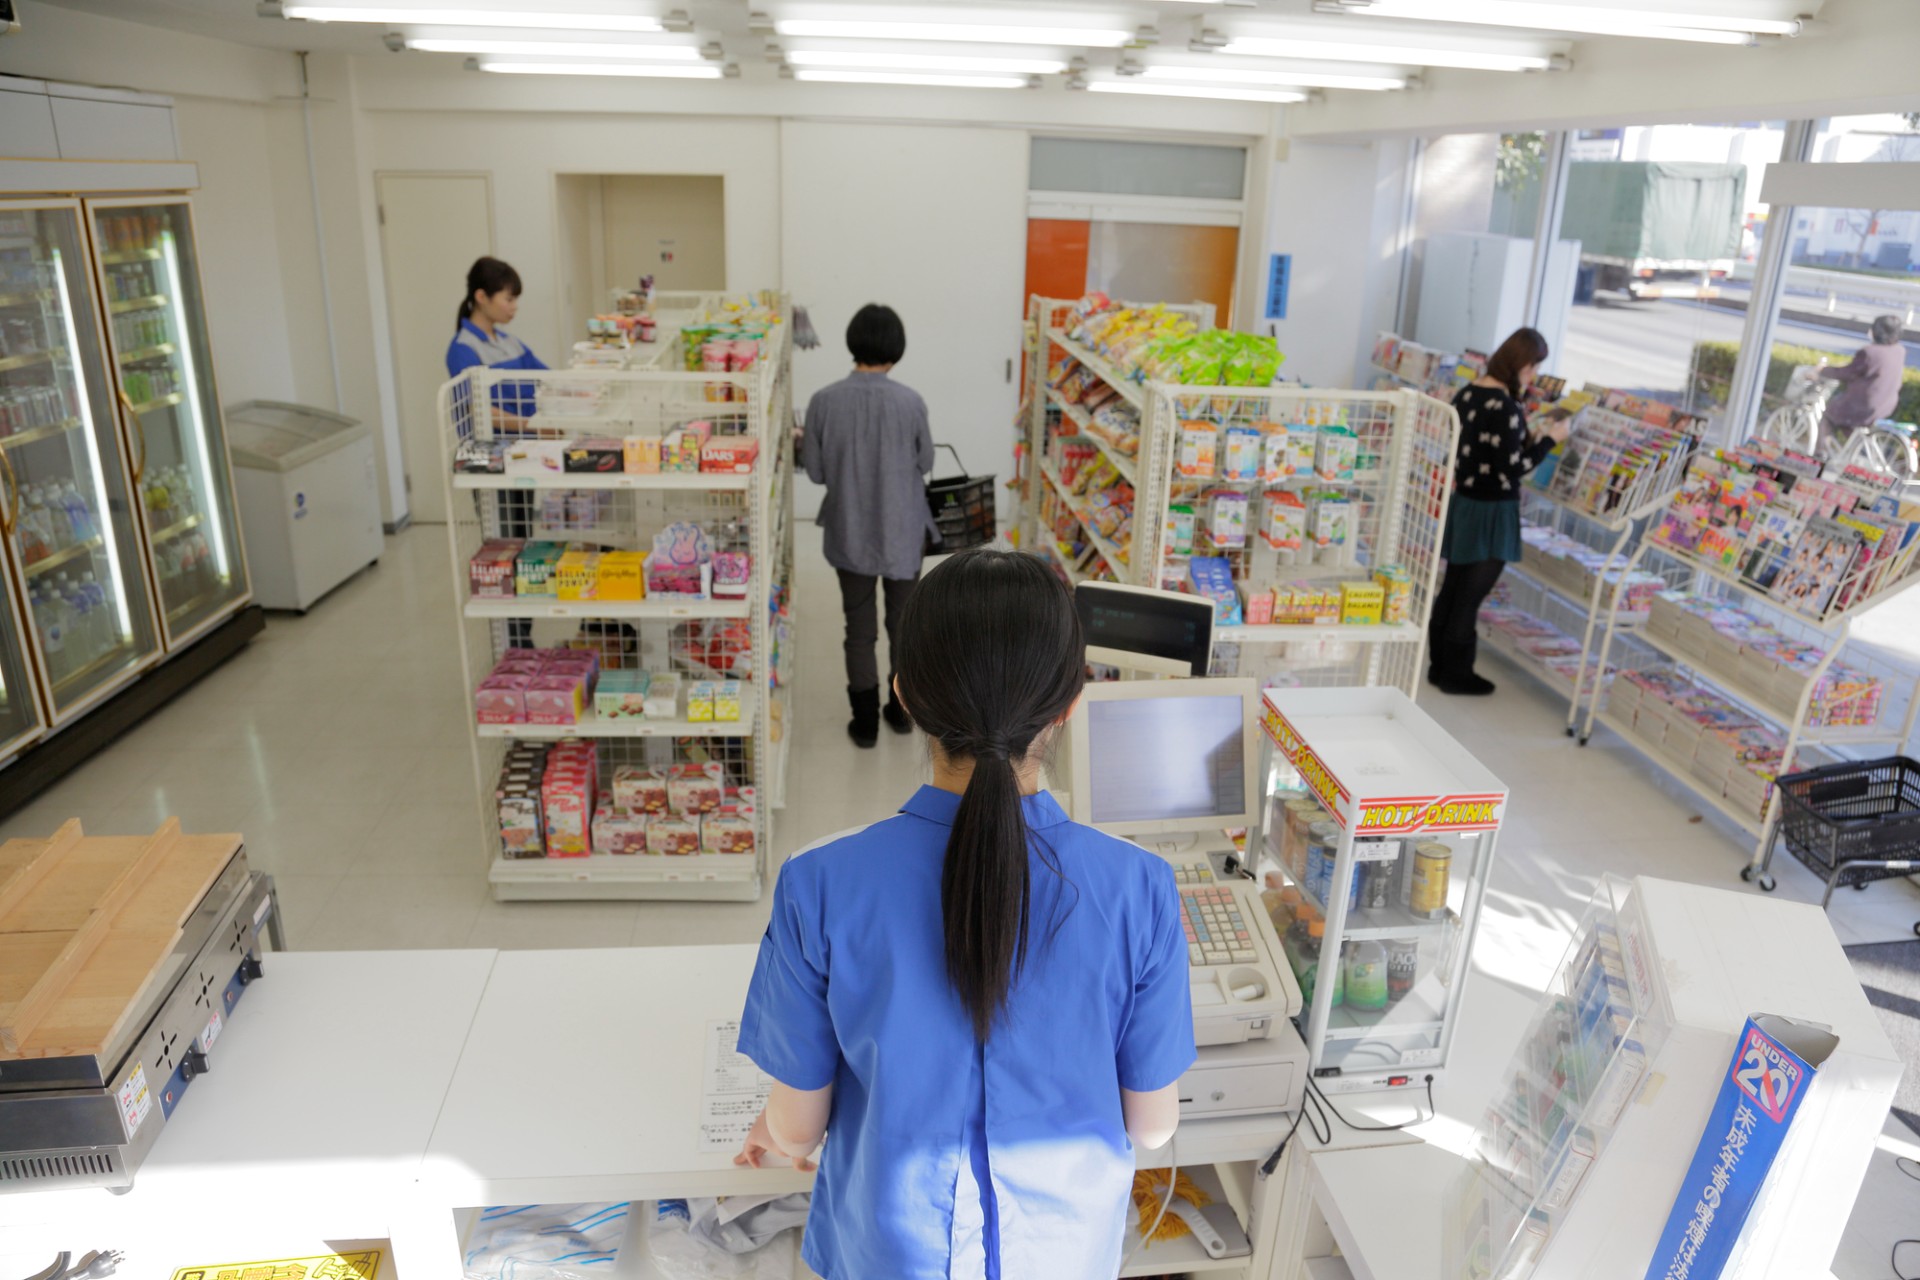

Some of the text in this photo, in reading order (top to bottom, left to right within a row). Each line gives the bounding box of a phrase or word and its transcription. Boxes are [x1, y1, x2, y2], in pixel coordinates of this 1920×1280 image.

[702, 448, 734, 462] DARS
[1266, 707, 1295, 755] HOT!
[1295, 743, 1339, 810] DRINK
[1361, 802, 1498, 828] HOT! DRINK
[1736, 1049, 1789, 1111] 20
[1751, 1034, 1798, 1080] UNDER
